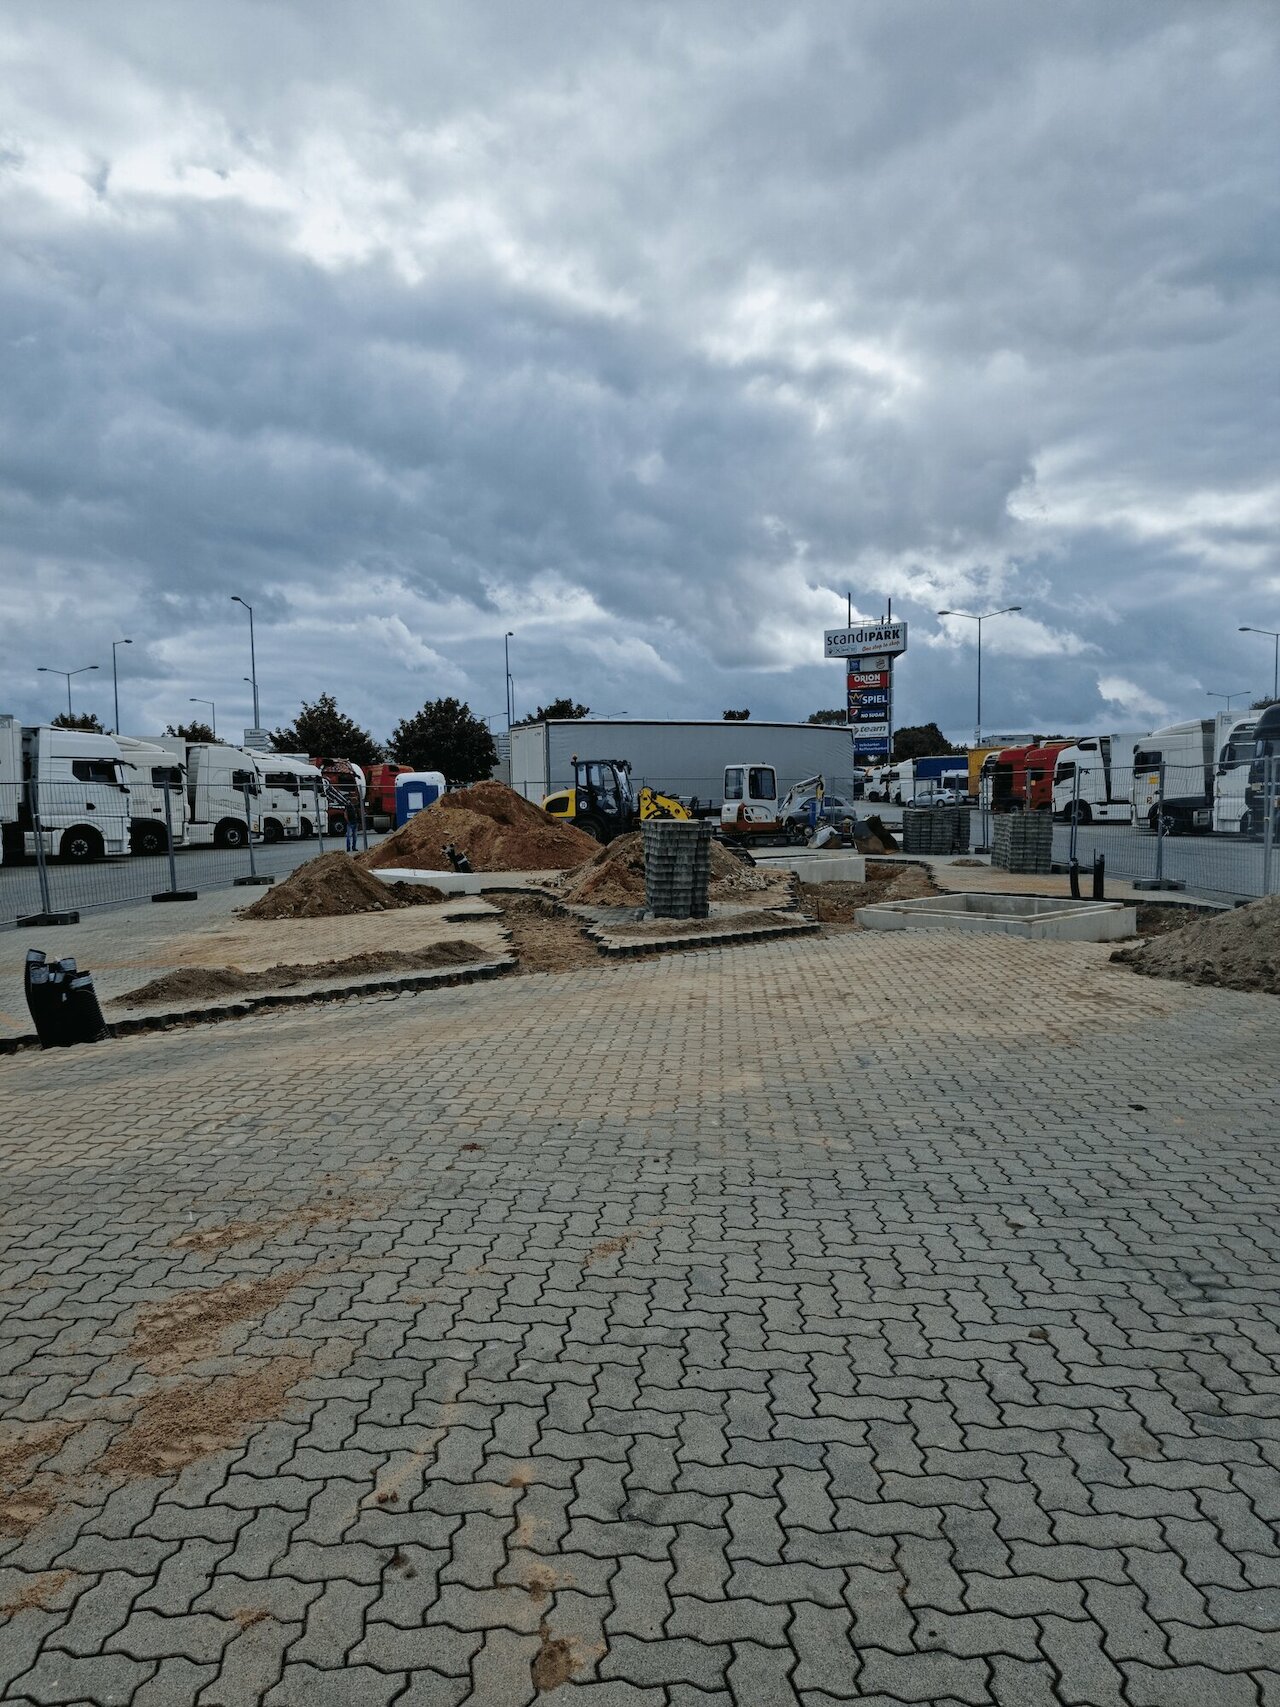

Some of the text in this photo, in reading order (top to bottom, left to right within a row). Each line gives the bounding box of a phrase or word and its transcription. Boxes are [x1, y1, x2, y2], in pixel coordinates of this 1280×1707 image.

[853, 673, 880, 684] ORION
[862, 695, 887, 704] SPIEL
[860, 725, 886, 733] team
